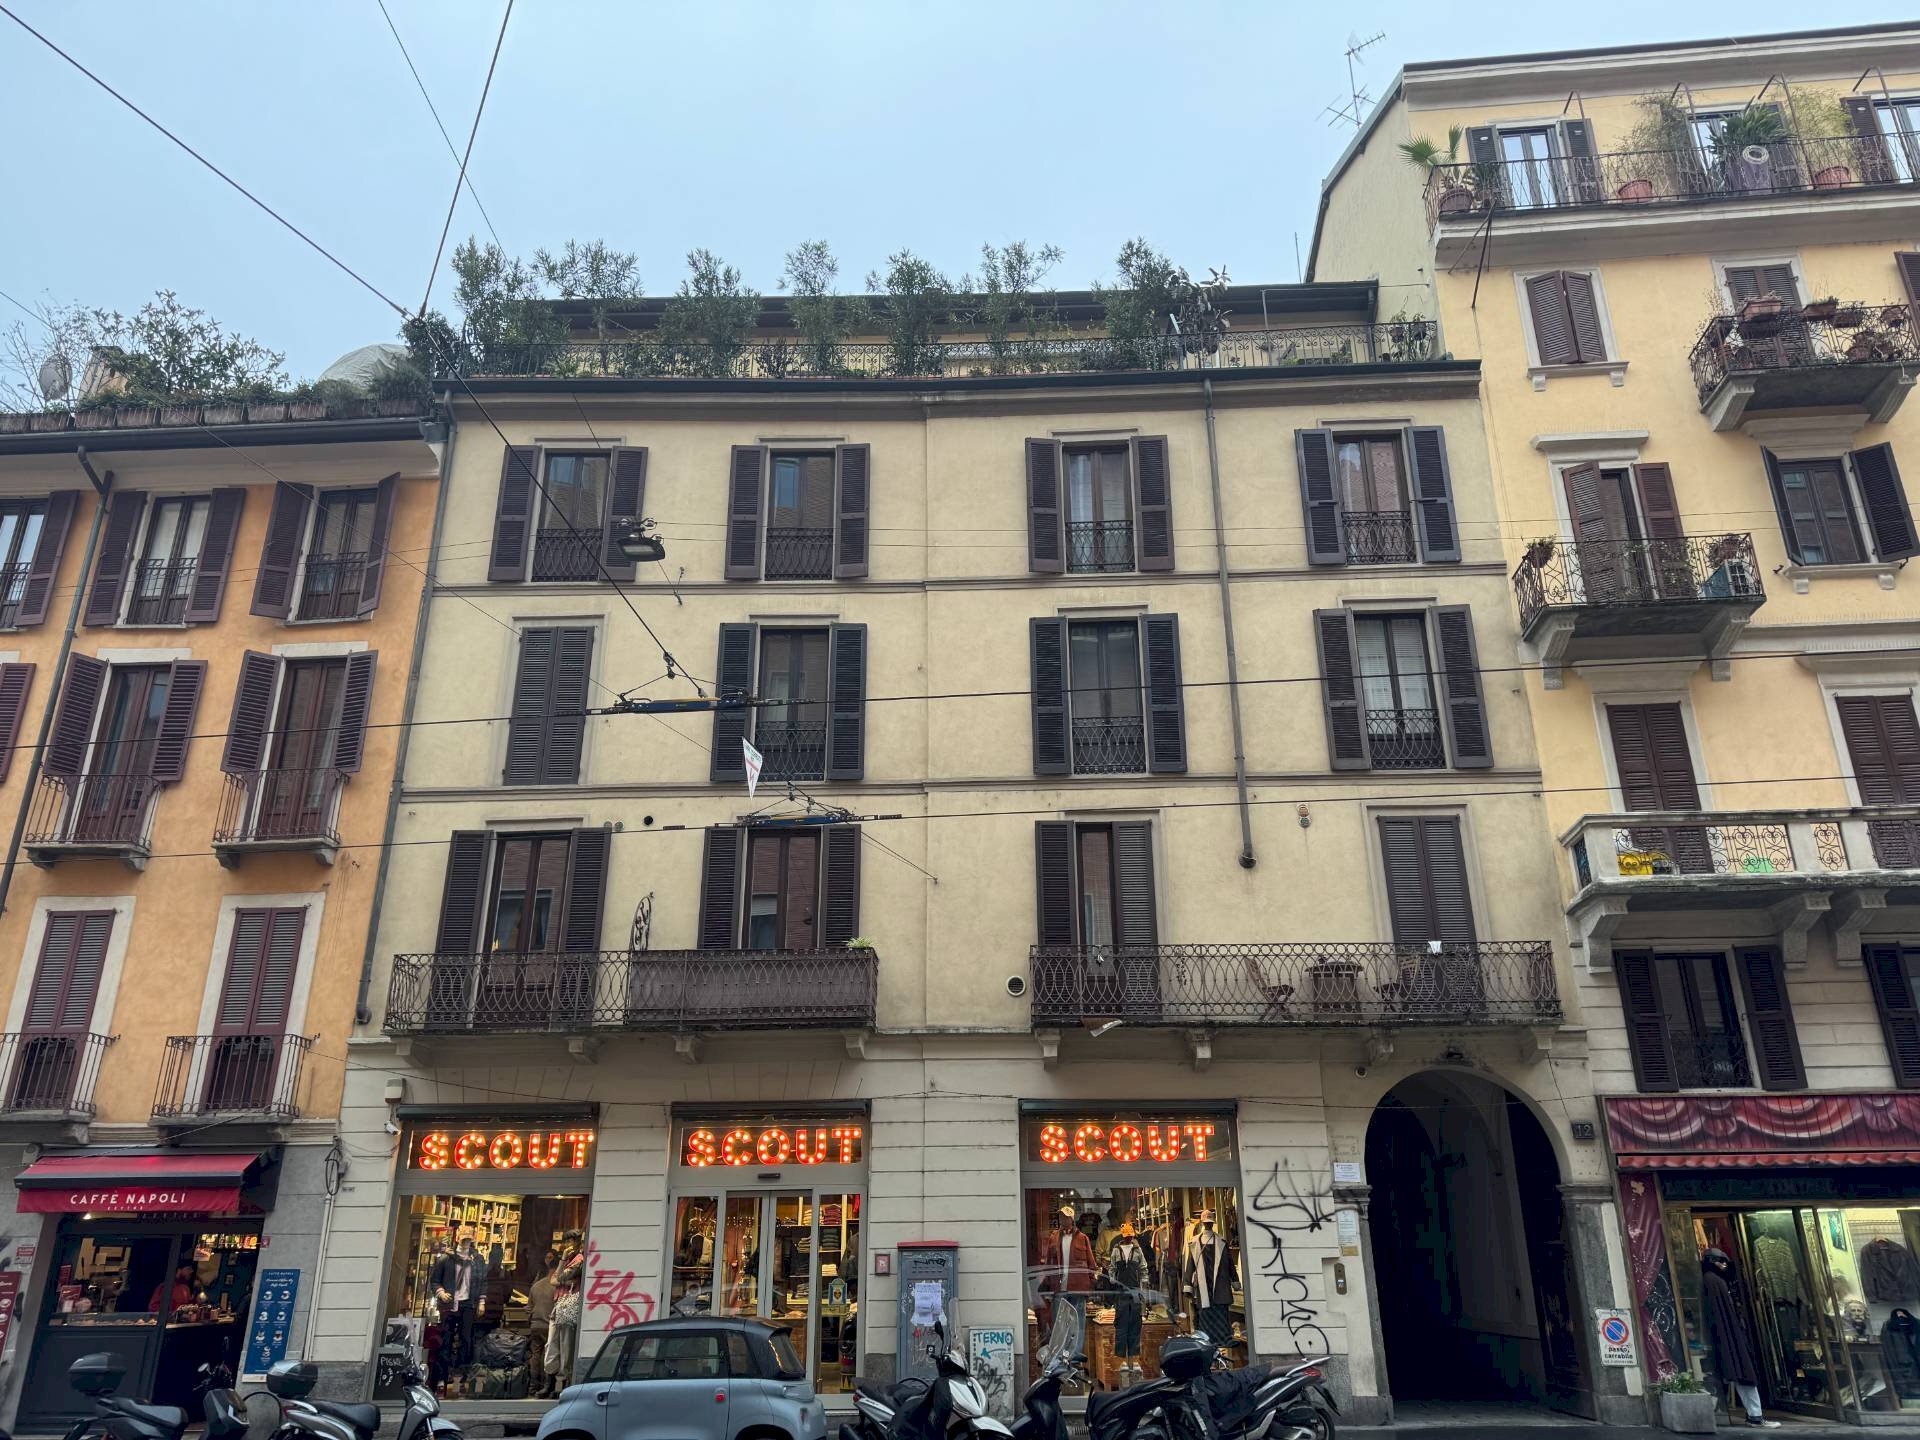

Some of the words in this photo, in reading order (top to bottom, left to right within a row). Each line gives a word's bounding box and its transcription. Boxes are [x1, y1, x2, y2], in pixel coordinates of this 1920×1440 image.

[686, 1128, 862, 1167] SCOUT
[1039, 1125, 1215, 1162] SCOUT
[1577, 1124, 1592, 1137] 12
[418, 1132, 594, 1169] SCOUT
[126, 1192, 186, 1204] NAPOLI
